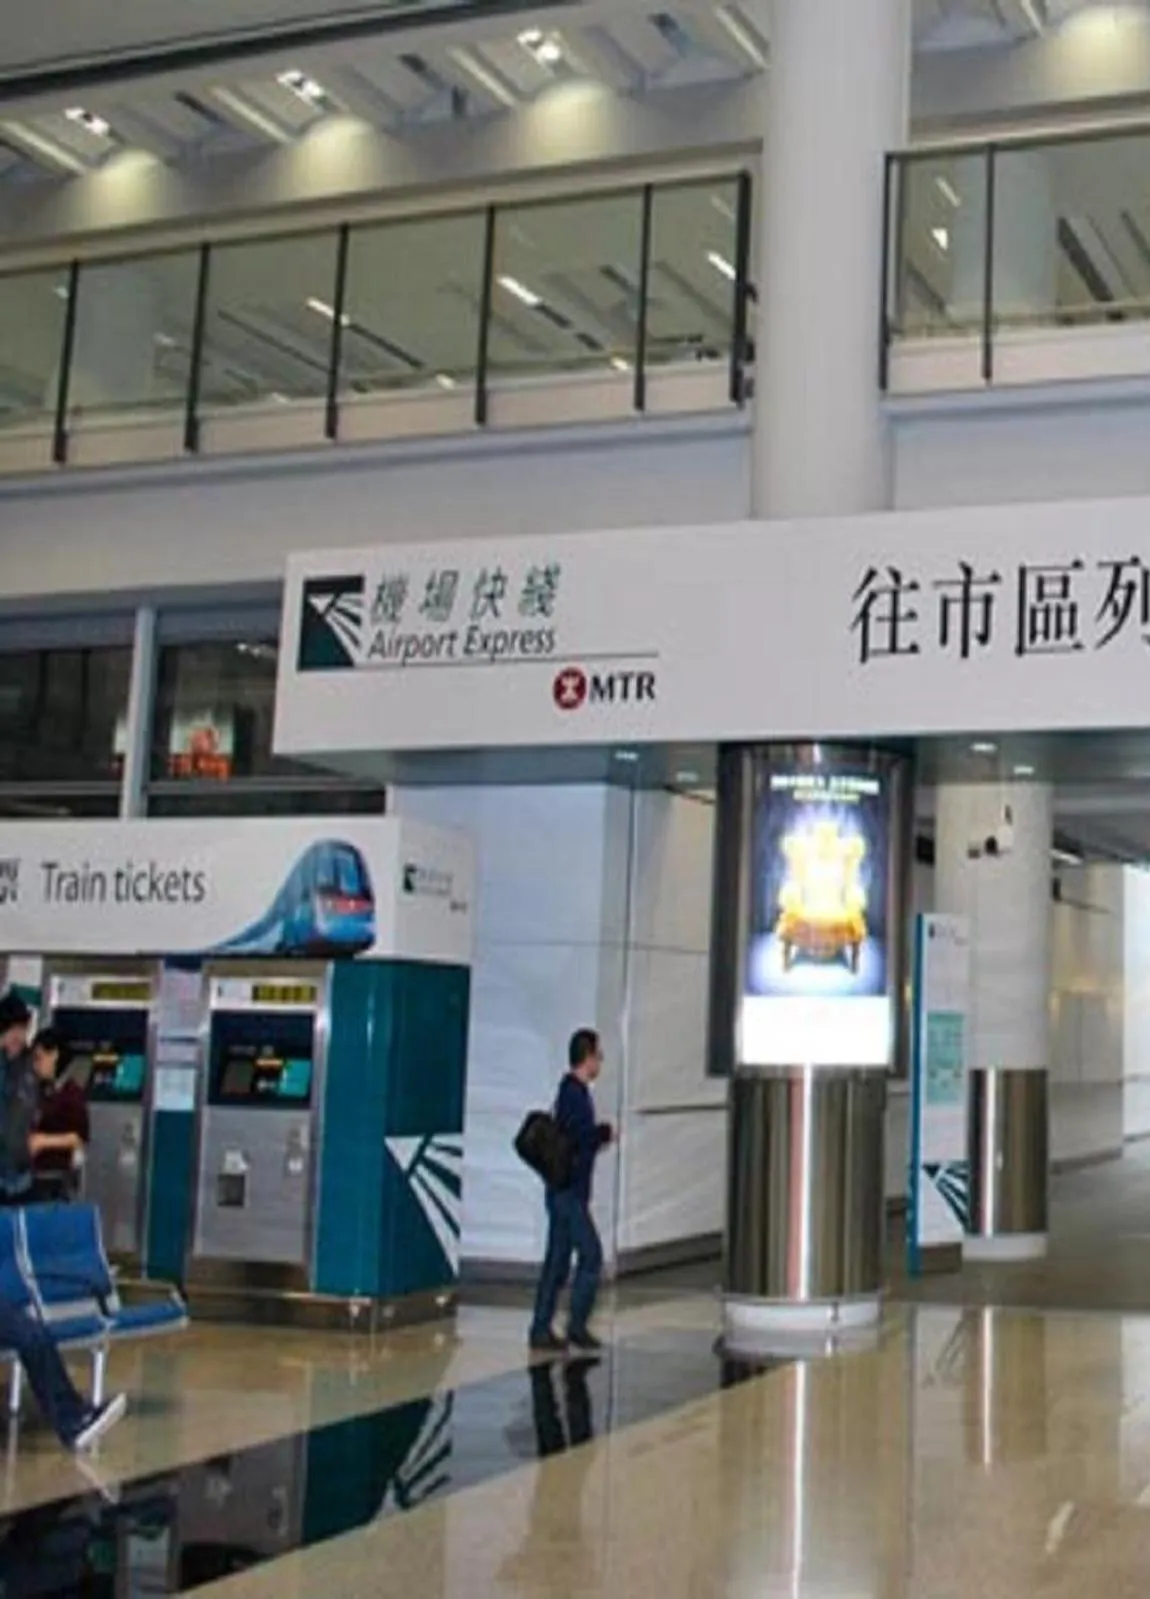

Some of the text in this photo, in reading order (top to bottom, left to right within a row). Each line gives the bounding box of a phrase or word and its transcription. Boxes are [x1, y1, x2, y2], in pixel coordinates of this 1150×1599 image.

[367, 625, 556, 667] Airport Express
[589, 670, 656, 702] MTR
[41, 859, 107, 902] Train
[114, 858, 206, 902] tickets
